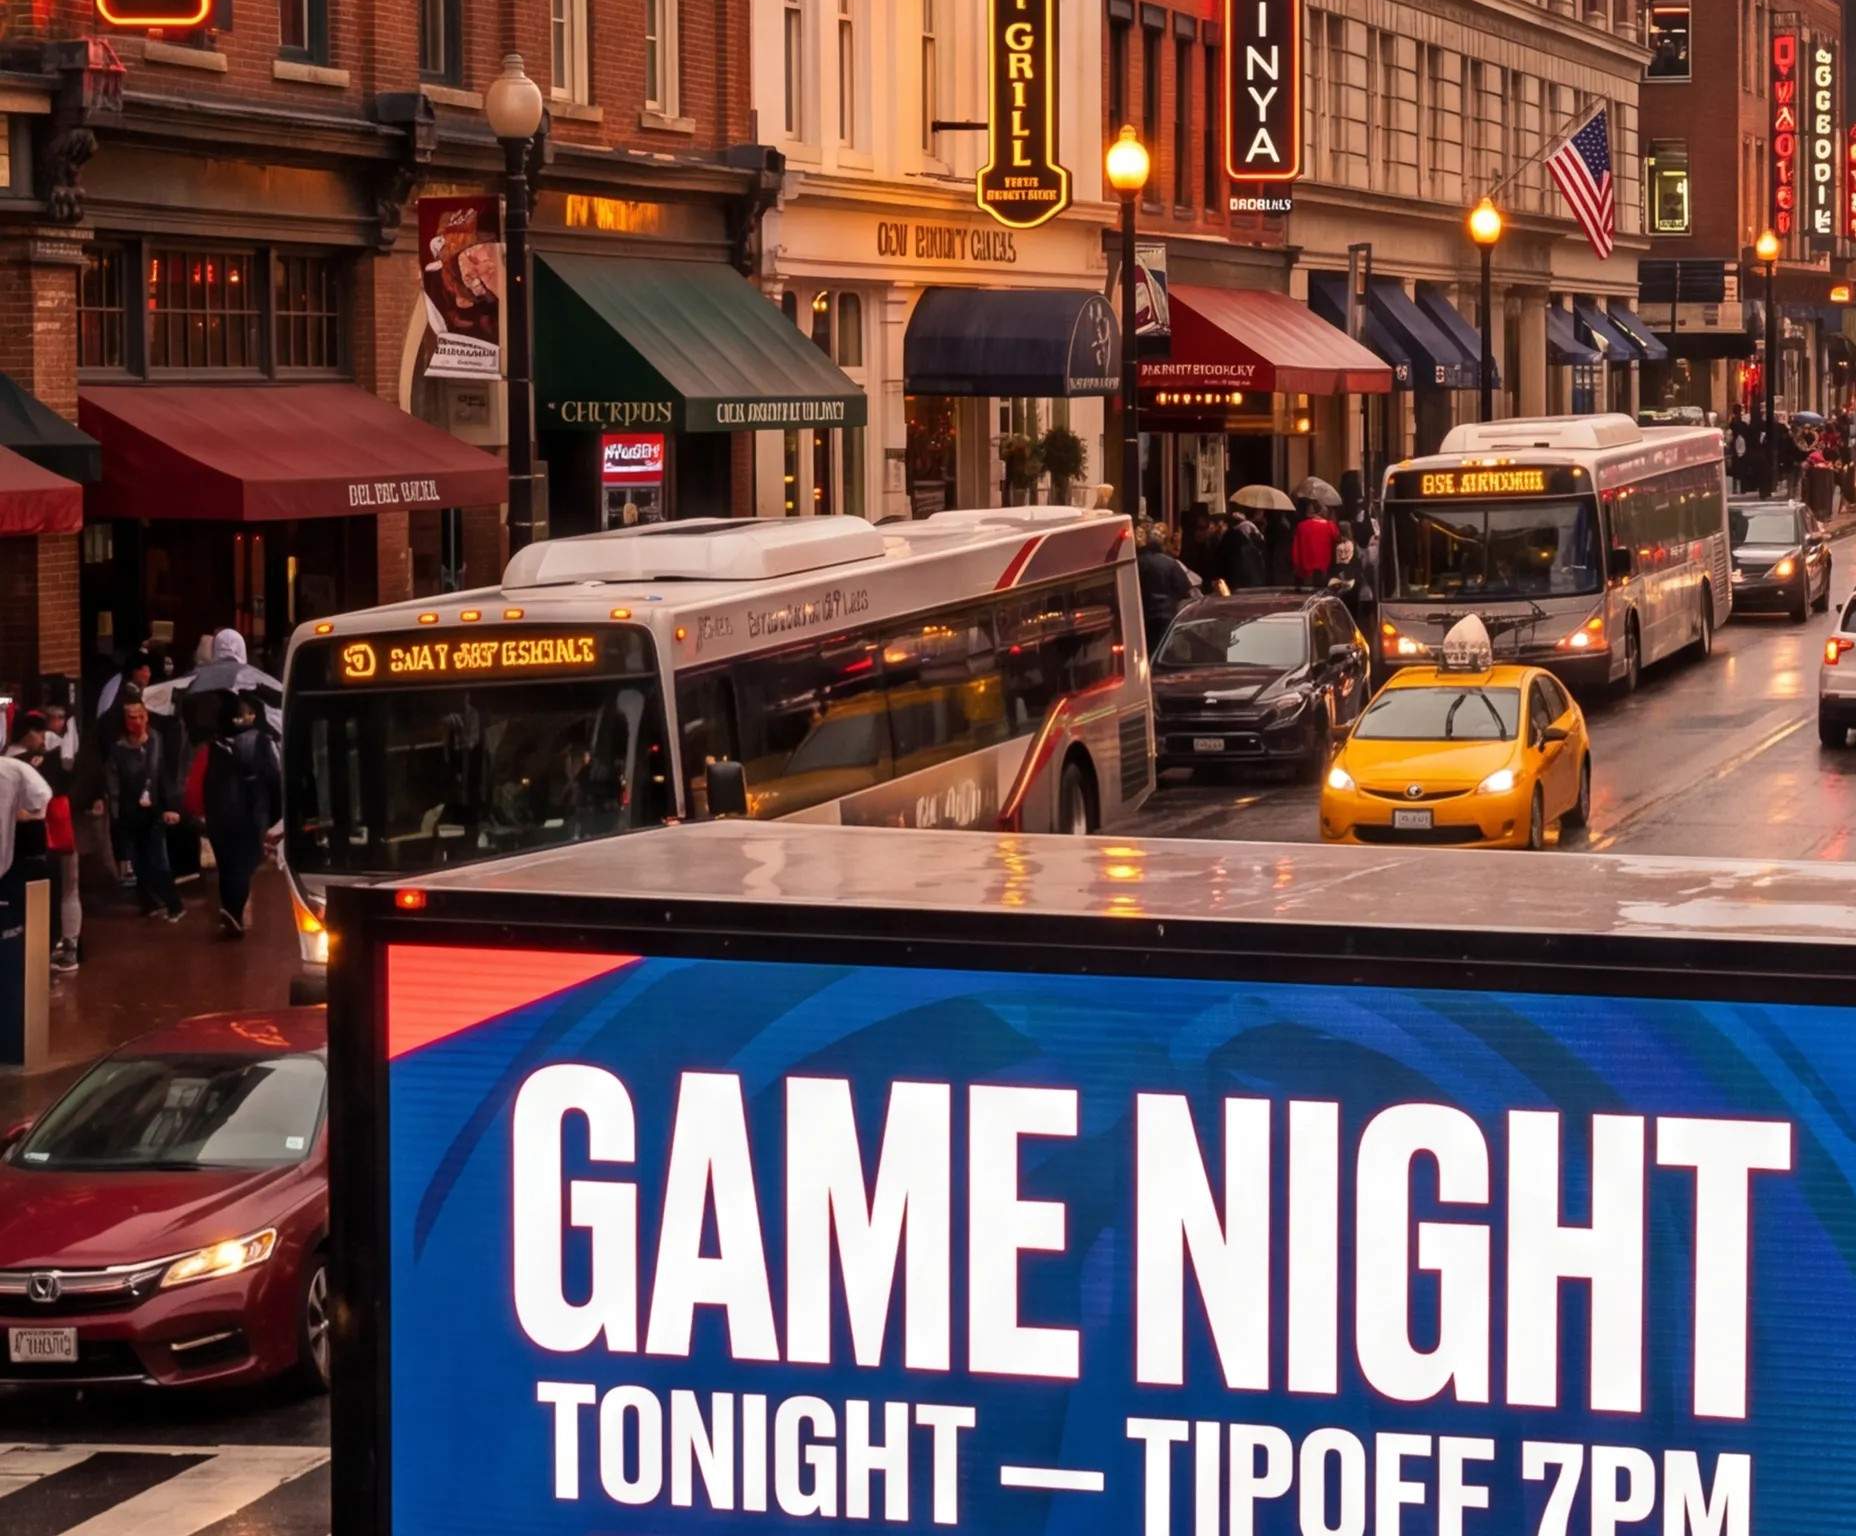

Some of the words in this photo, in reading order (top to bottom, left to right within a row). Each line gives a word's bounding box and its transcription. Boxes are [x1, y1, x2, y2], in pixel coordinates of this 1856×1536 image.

[1005, 22, 1034, 167] GRILL
[511, 1063, 1080, 1376] GAME
[1135, 1094, 1793, 1418] NIGHT
[536, 1381, 976, 1526] TONIGHT
